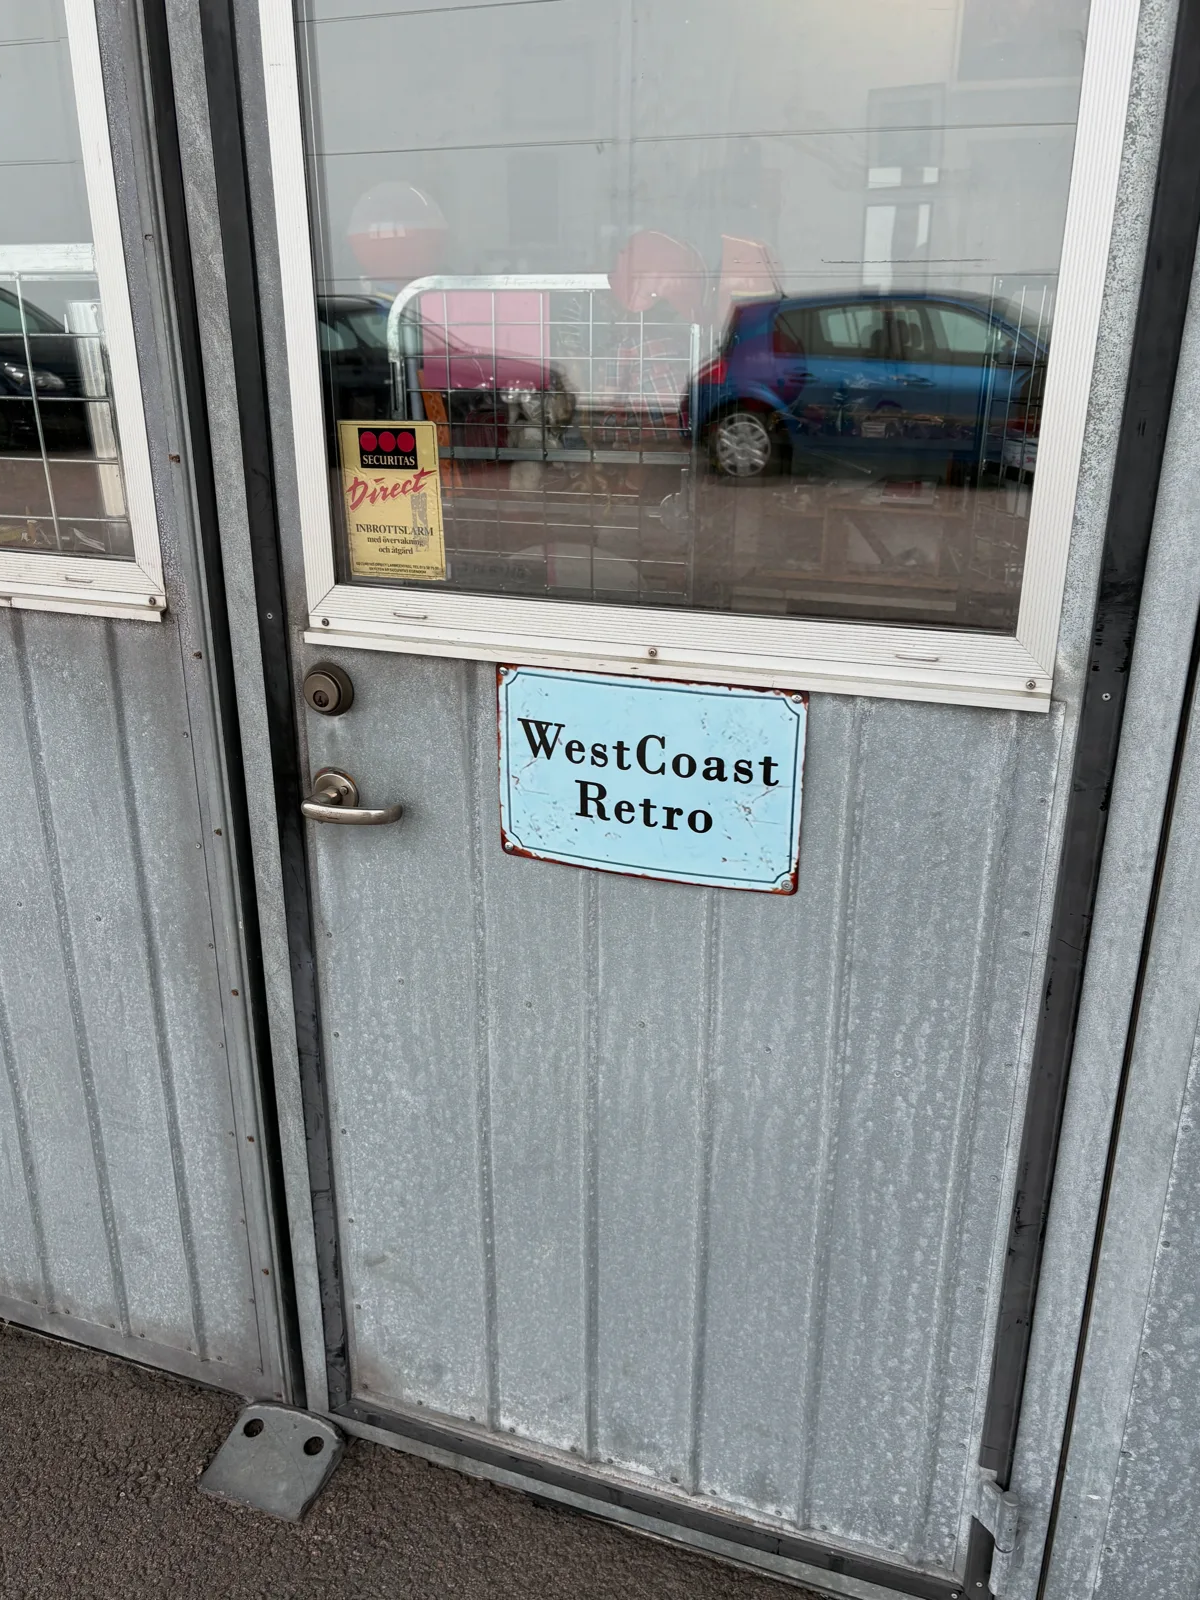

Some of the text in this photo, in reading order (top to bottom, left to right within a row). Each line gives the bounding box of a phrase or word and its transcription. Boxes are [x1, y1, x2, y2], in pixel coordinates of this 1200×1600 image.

[362, 454, 416, 466] SECURITAS
[346, 467, 437, 511] Direct
[356, 523, 434, 536] INBROTTSLARM
[367, 536, 382, 544] med
[391, 546, 414, 556] åtgärd
[517, 717, 780, 787] WestCoast
[574, 779, 714, 834] Retro
